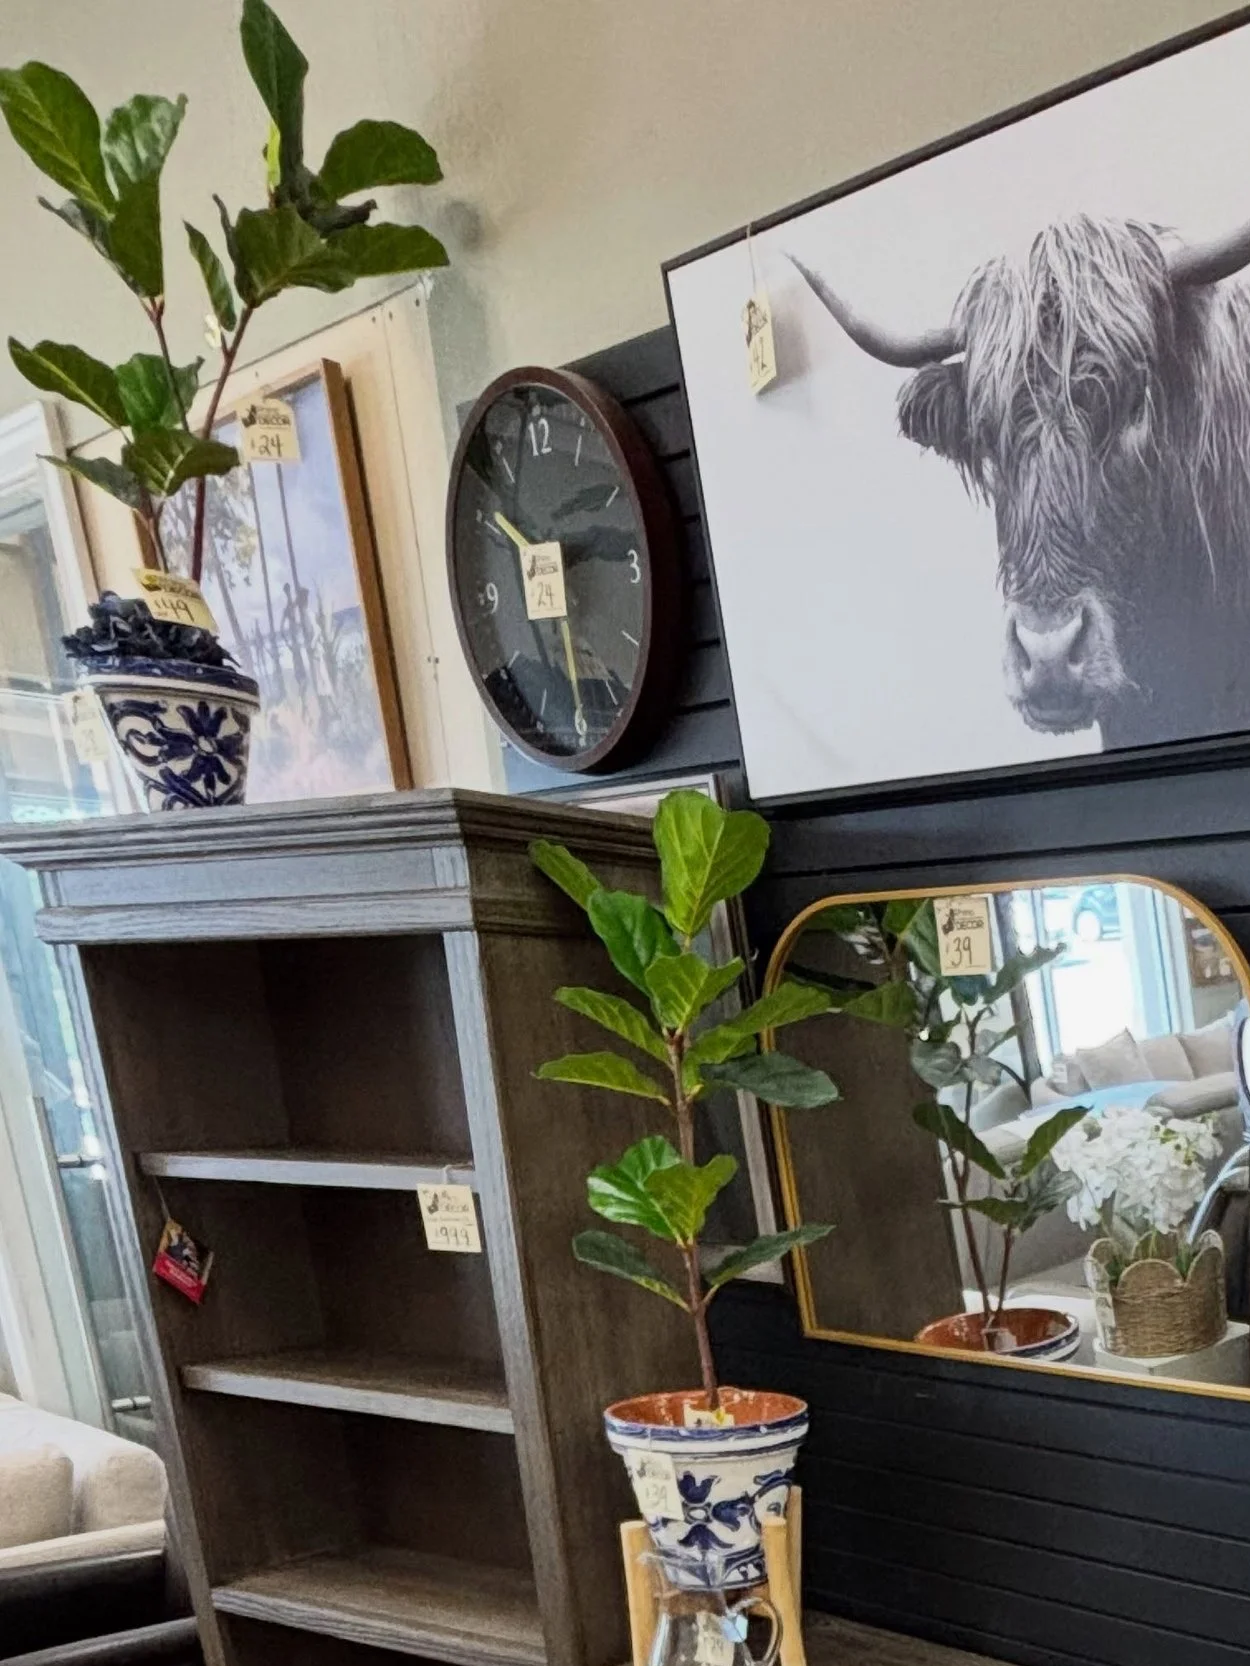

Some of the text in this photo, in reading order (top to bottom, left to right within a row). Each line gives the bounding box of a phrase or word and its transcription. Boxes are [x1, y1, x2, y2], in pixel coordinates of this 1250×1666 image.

[529, 418, 552, 456] 12
[628, 549, 641, 584] 3
[486, 582, 499, 614] 9
